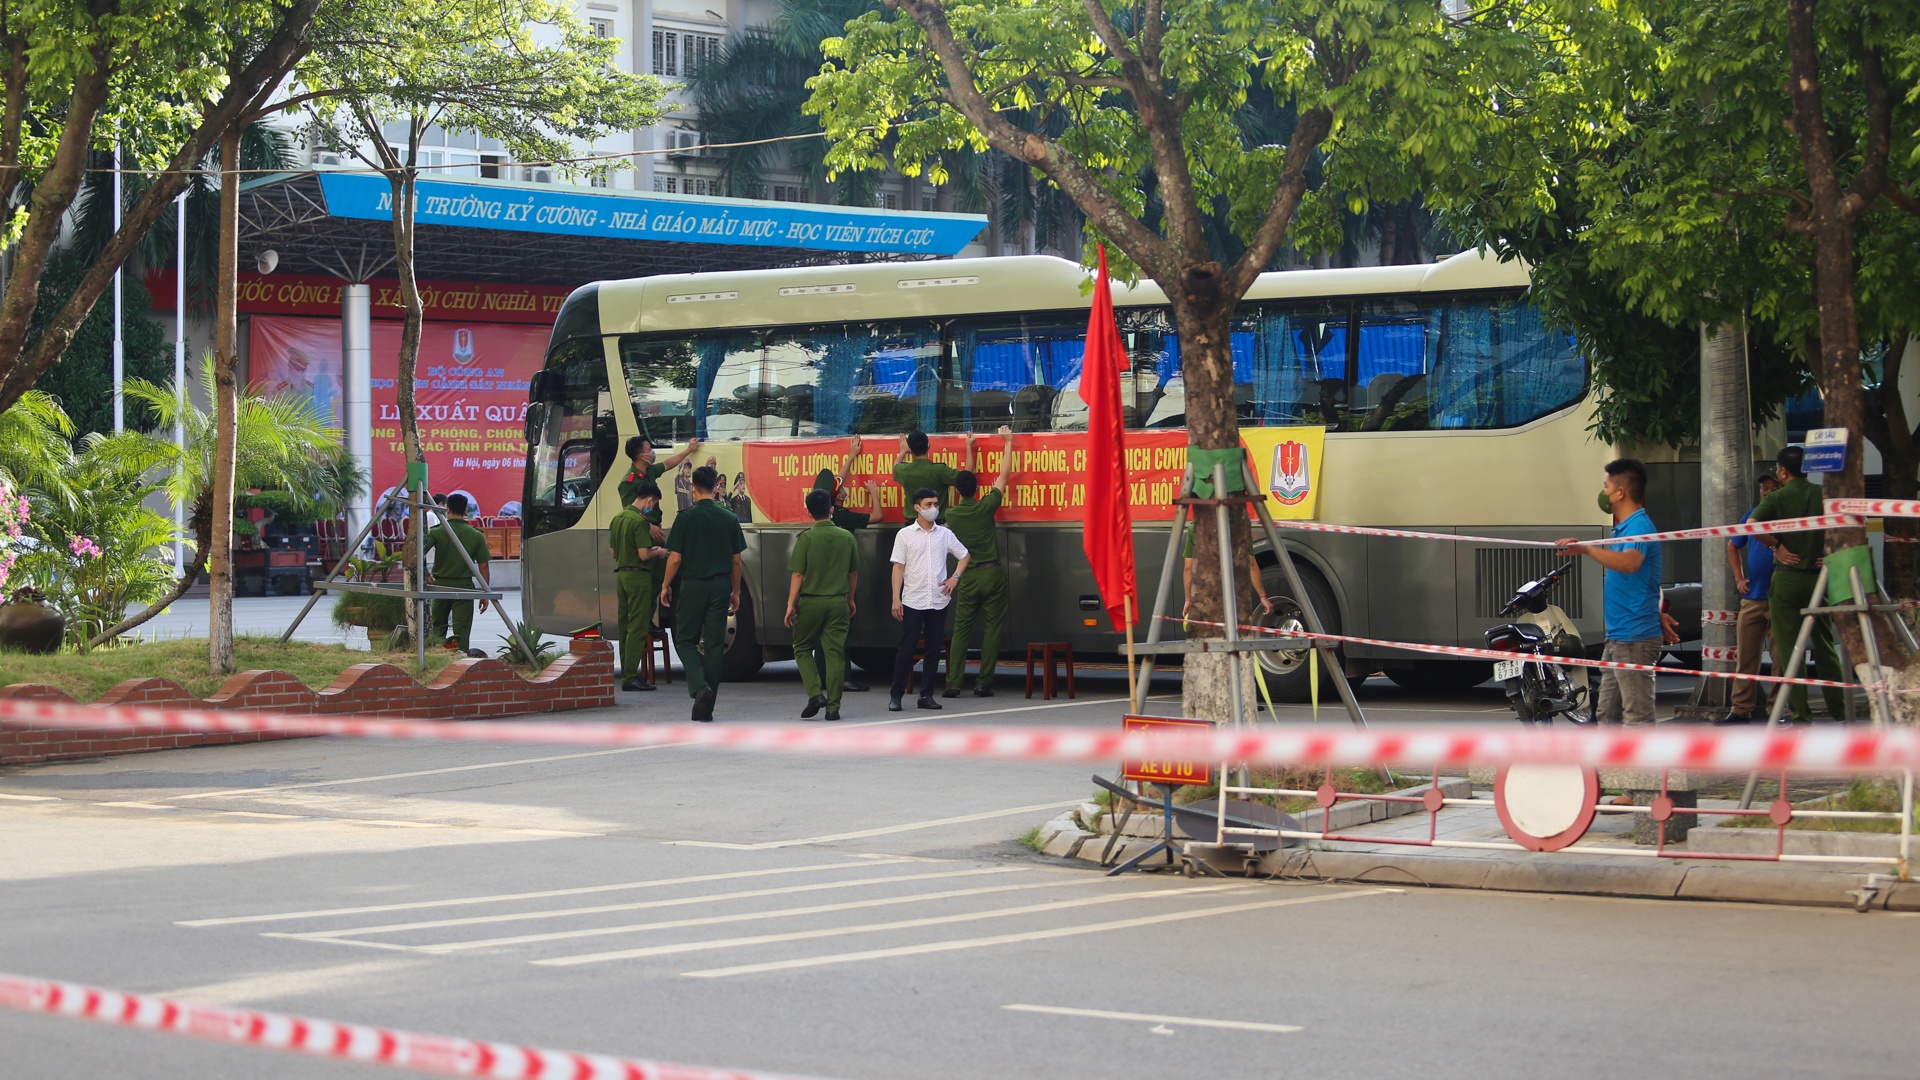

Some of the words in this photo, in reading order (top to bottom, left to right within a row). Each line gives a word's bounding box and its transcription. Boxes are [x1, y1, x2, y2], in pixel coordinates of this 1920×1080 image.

[425, 193, 501, 220] TRƯỜNG
[503, 197, 535, 222] KỶ
[535, 205, 597, 228] CƯƠNG
[608, 209, 647, 231] NHÀ
[651, 211, 697, 233] GIÁO
[697, 210, 739, 236] MẪU
[739, 219, 778, 242] MỰC
[785, 223, 821, 244] HỌC
[865, 223, 904, 244] TÍCH
[904, 228, 935, 249] CỰC
[277, 280, 331, 307] CỘNG
[441, 285, 480, 309] CHỦ
[484, 290, 536, 312] NGHĨA
[427, 365, 446, 379] BỘ
[447, 365, 484, 378] CÔNG
[485, 368, 505, 378] AN
[469, 377, 494, 390] SÁT
[416, 398, 480, 421] XUẤT
[485, 400, 528, 422] QUÂ
[486, 426, 526, 438] CHỐN
[389, 442, 406, 453] TẠ
[484, 440, 516, 452] PHÍA
[453, 457, 464, 468] Hà
[466, 457, 480, 470] Nội,
[482, 458, 500, 470] ngày
[502, 457, 512, 468] 06
[877, 453, 893, 475] AN
[987, 450, 1021, 473] CHN
[1024, 445, 1070, 474] PHÒNG,
[1154, 447, 1188, 471] COVI
[1016, 480, 1046, 512] TRẬT
[1049, 482, 1068, 511] TỰ,
[1130, 478, 1148, 506] XÃ
[1499, 667, 1519, 679] 6738
